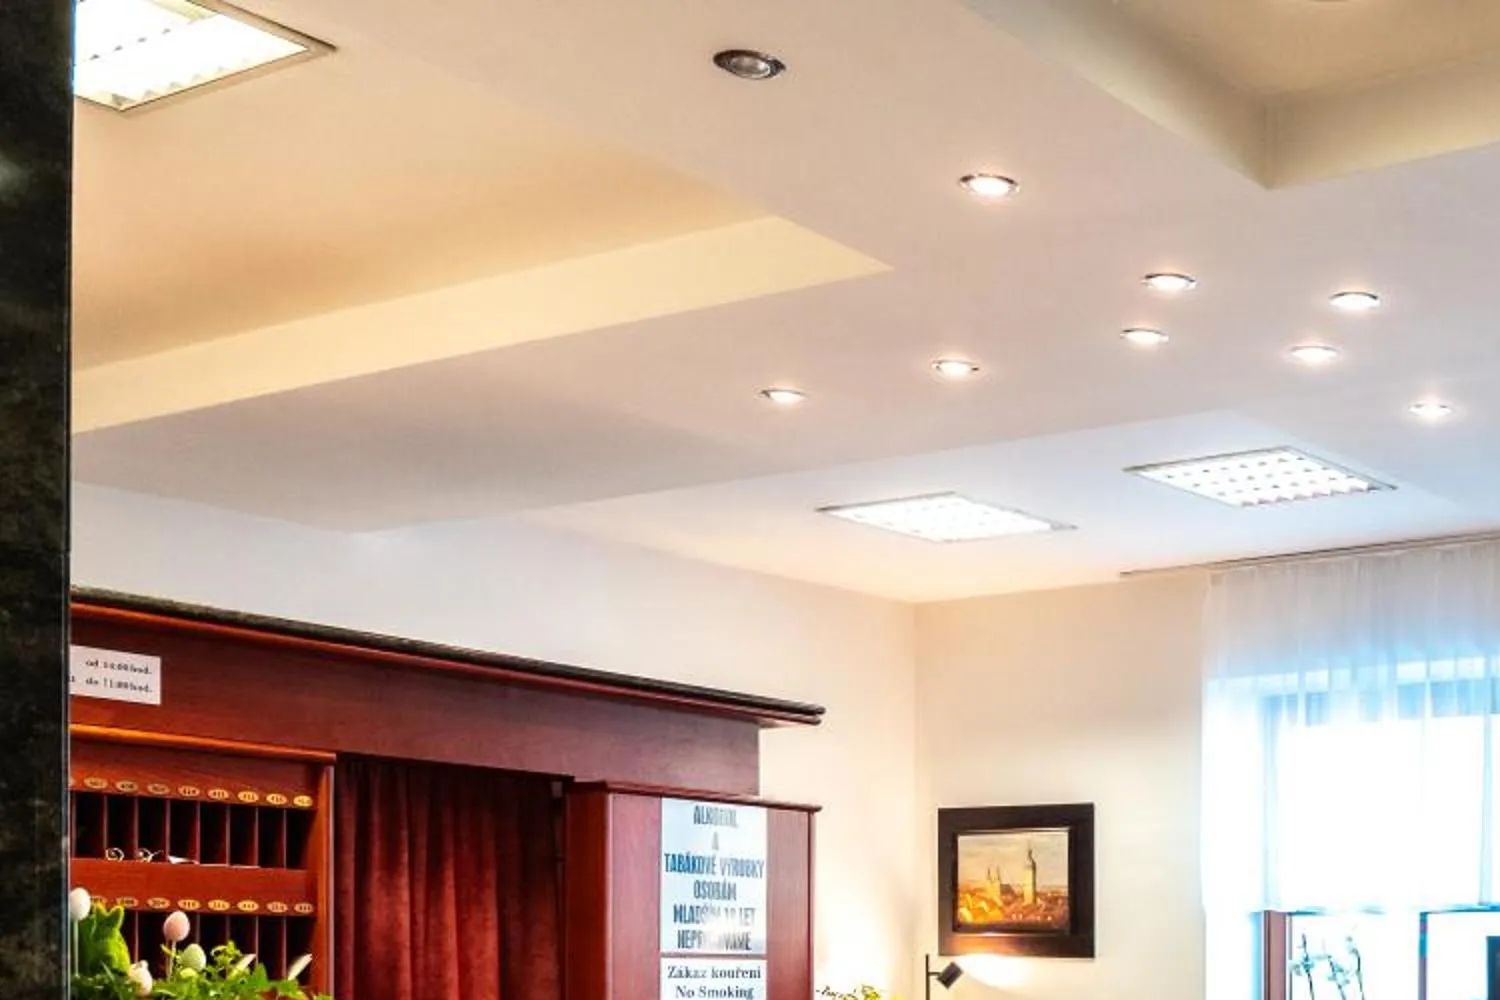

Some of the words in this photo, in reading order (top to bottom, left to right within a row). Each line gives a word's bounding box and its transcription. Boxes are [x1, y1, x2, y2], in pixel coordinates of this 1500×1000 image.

[711, 832, 720, 850] A
[664, 851, 717, 875] TABÁKOVÉ
[693, 878, 737, 901] OSOBÁM
[667, 964, 708, 980] Zákaz
[711, 964, 761, 980] kouření
[675, 985, 695, 999] No
[698, 984, 755, 1000] Smoking
